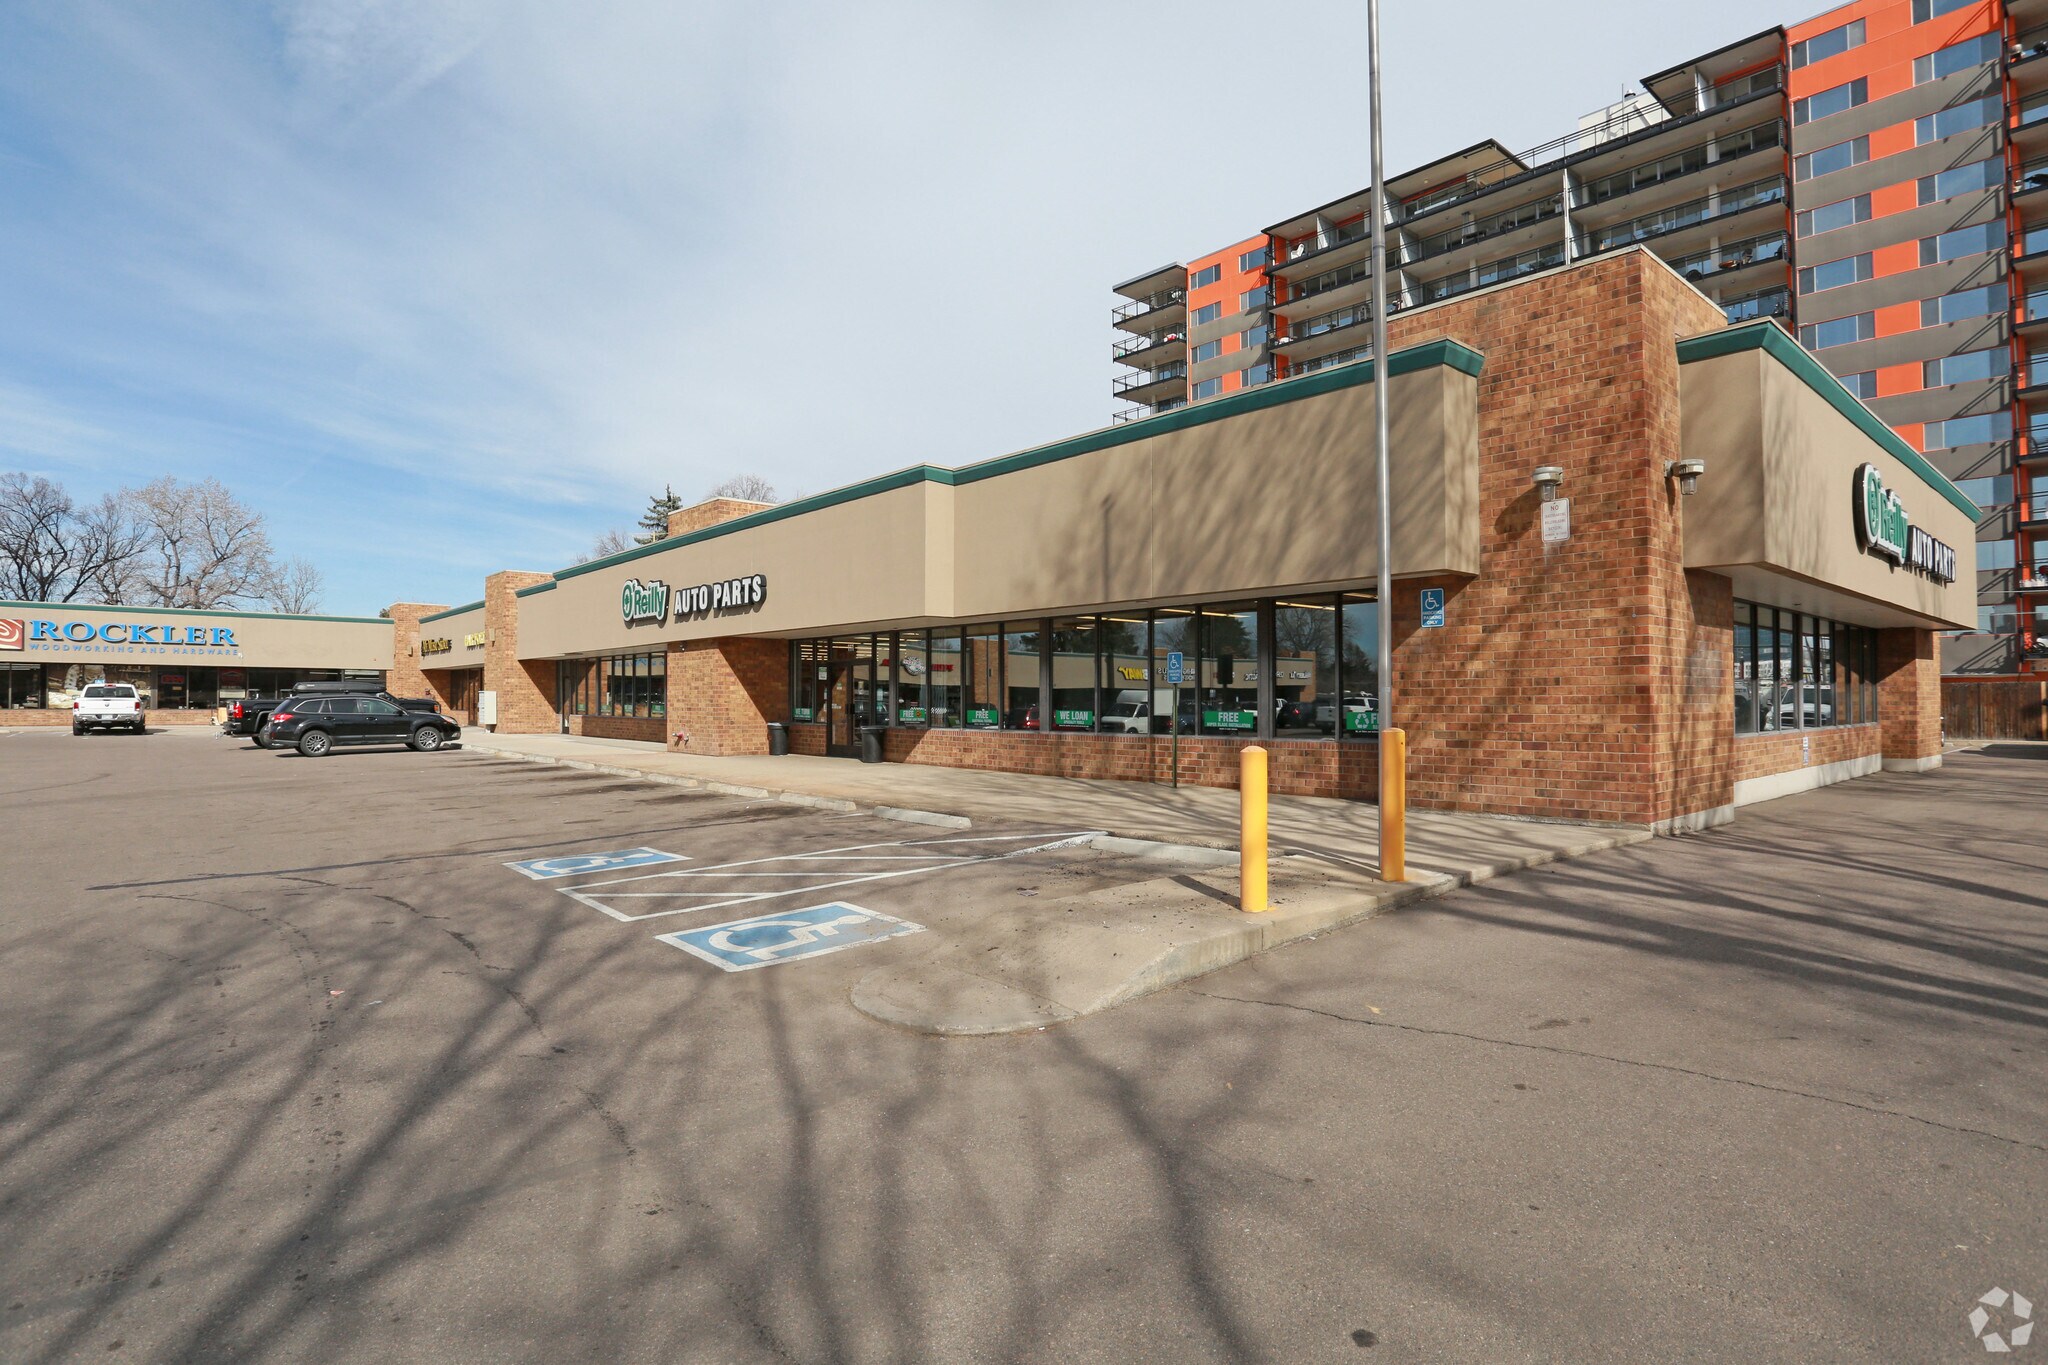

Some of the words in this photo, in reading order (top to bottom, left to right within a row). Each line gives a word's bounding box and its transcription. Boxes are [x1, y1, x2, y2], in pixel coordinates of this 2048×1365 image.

[1864, 464, 1908, 564] O'Reilly
[1911, 527, 1933, 570] AUTO
[1934, 540, 1955, 581] PARTS
[622, 579, 668, 621] O'Reilly
[674, 584, 709, 615] AUTO
[713, 575, 763, 609] PARTS
[29, 620, 239, 646] ROCKLER
[30, 643, 134, 653] WOODWORKING
[173, 648, 238, 656] HARDWARE
[902, 710, 914, 718] FREE
[975, 710, 989, 719] FREE
[1060, 711, 1070, 720] WE
[1071, 711, 1089, 721] LOAN
[1218, 712, 1239, 722] FREE
